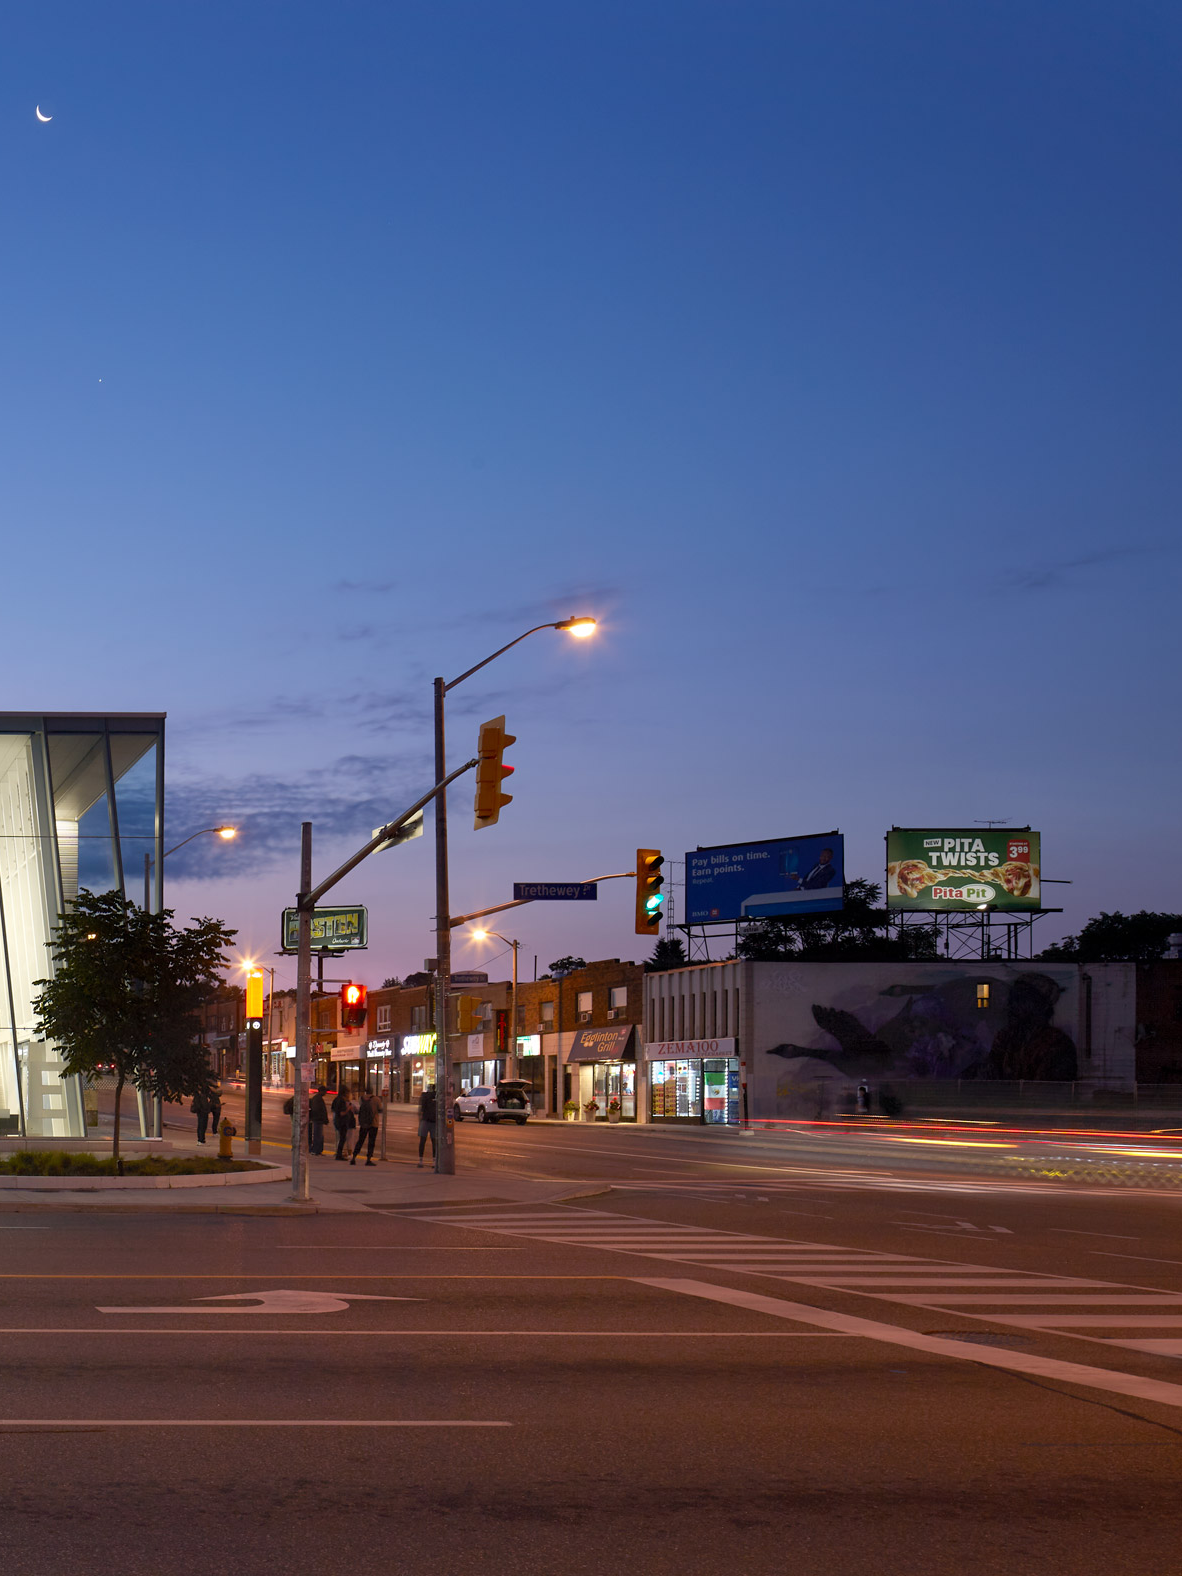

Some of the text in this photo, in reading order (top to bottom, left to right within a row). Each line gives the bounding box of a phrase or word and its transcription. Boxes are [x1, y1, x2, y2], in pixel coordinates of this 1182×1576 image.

[944, 838, 985, 852] PITA
[692, 858, 708, 867] Pay
[711, 855, 729, 864] bills
[746, 851, 770, 860] time.
[929, 852, 999, 866] TWISTS
[692, 864, 744, 877] Earn points.
[519, 884, 580, 899] Trethewey
[933, 887, 986, 898] Pita Pit
[401, 1034, 437, 1056] SUBWAY
[597, 1041, 616, 1053] Grill
